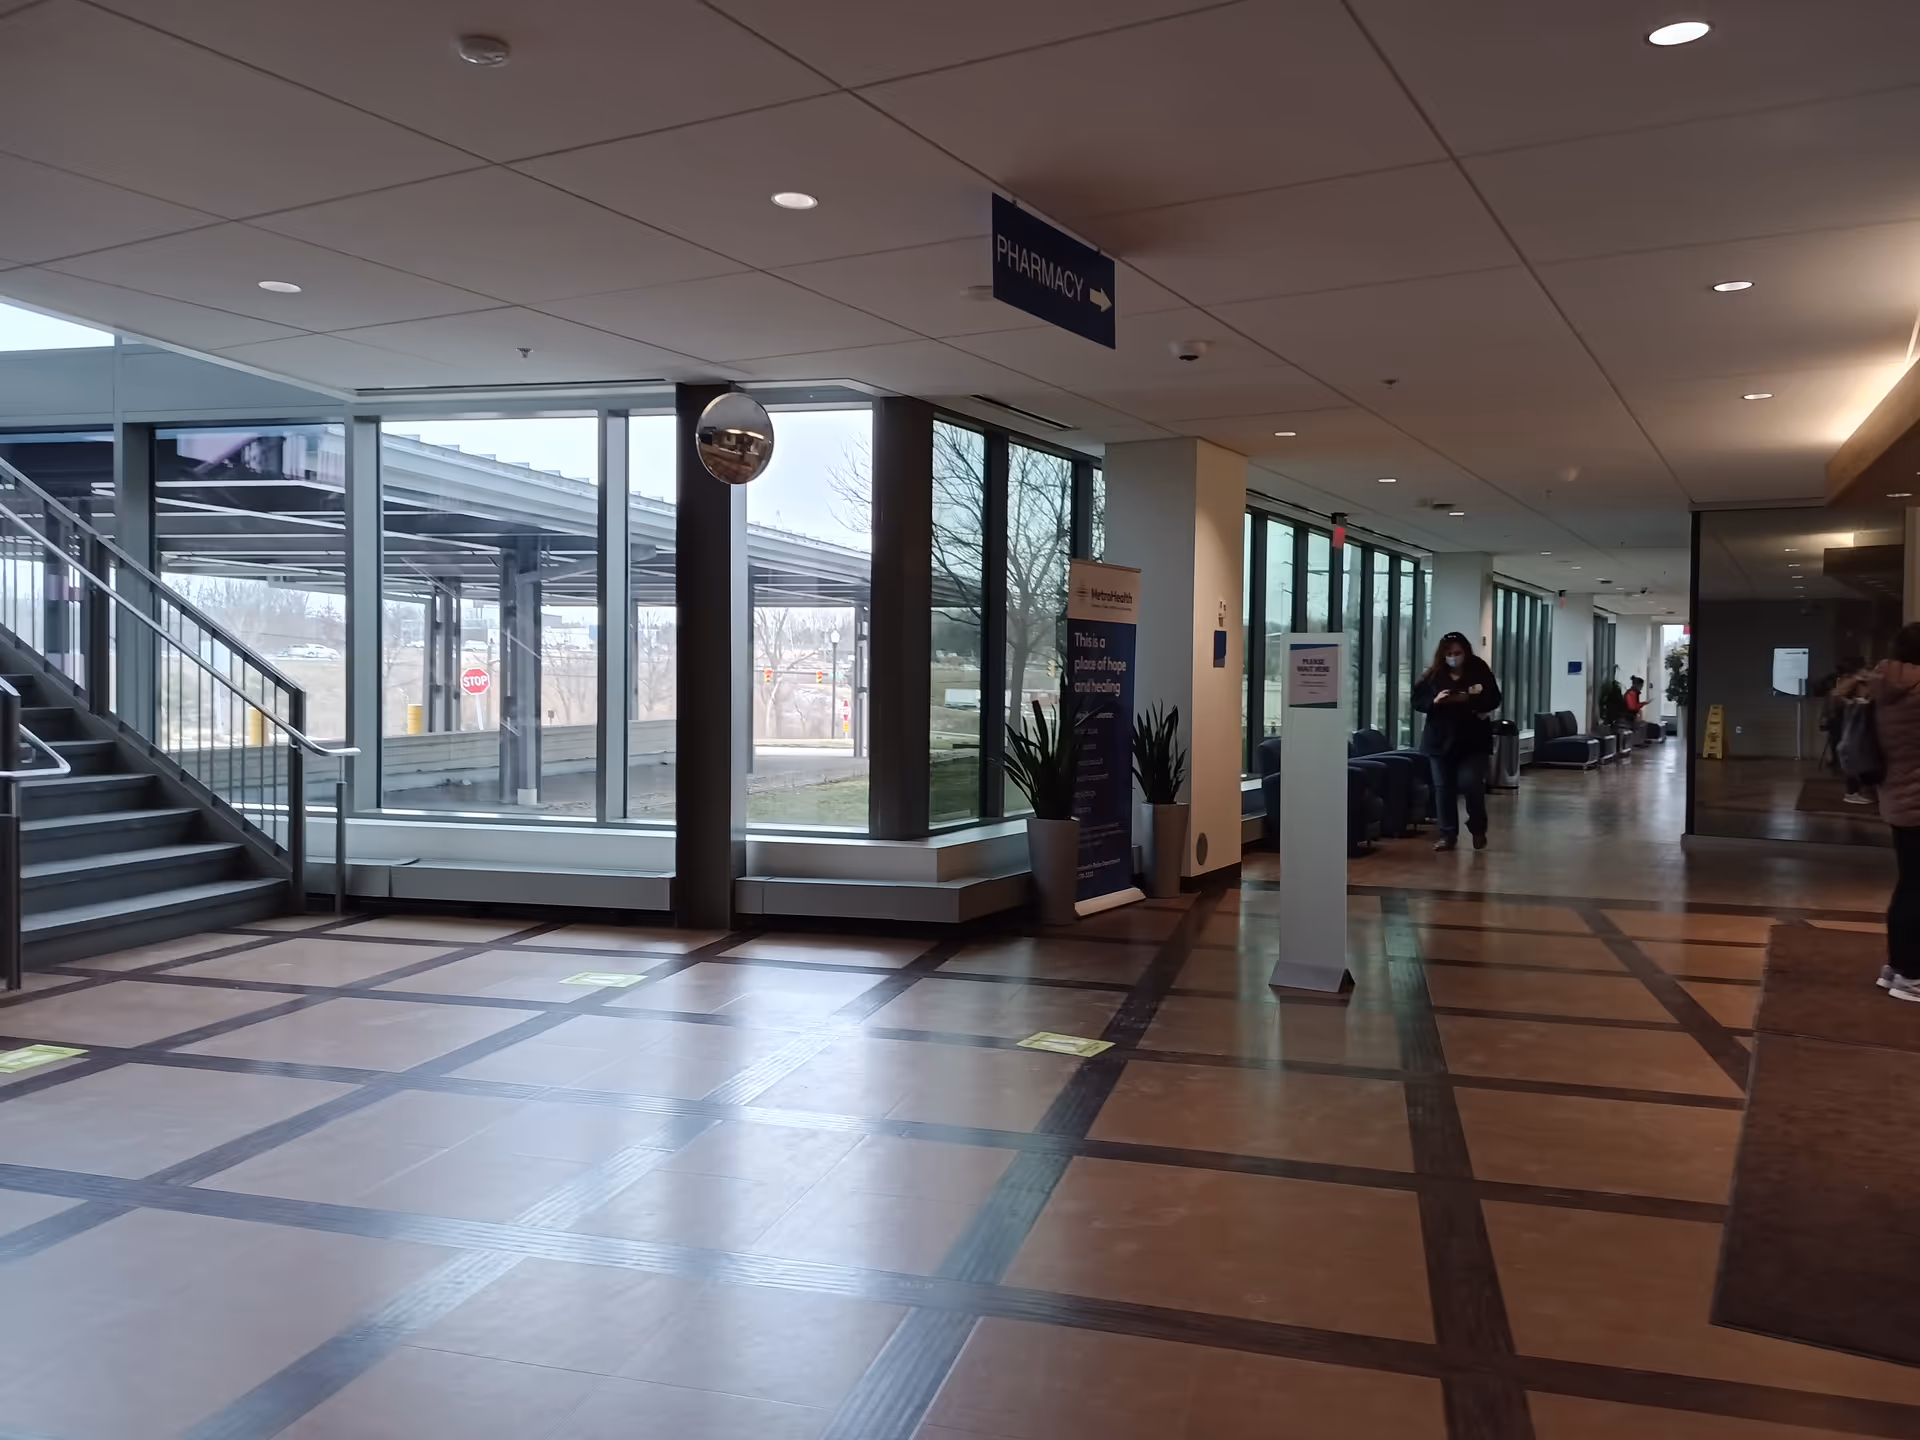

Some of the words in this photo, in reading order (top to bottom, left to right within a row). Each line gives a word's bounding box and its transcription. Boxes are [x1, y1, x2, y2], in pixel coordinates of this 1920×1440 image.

[997, 233, 1084, 302] PHARMACY
[1091, 588, 1133, 604] MetroHealth
[1074, 632, 1091, 648] This
[1092, 633, 1098, 648] is
[1099, 638, 1106, 649] a
[1074, 655, 1096, 674] place
[1097, 656, 1107, 671] of
[1107, 657, 1127, 675] hope
[463, 675, 488, 687] STOP
[1074, 679, 1091, 693] and
[1091, 679, 1121, 697] healing
